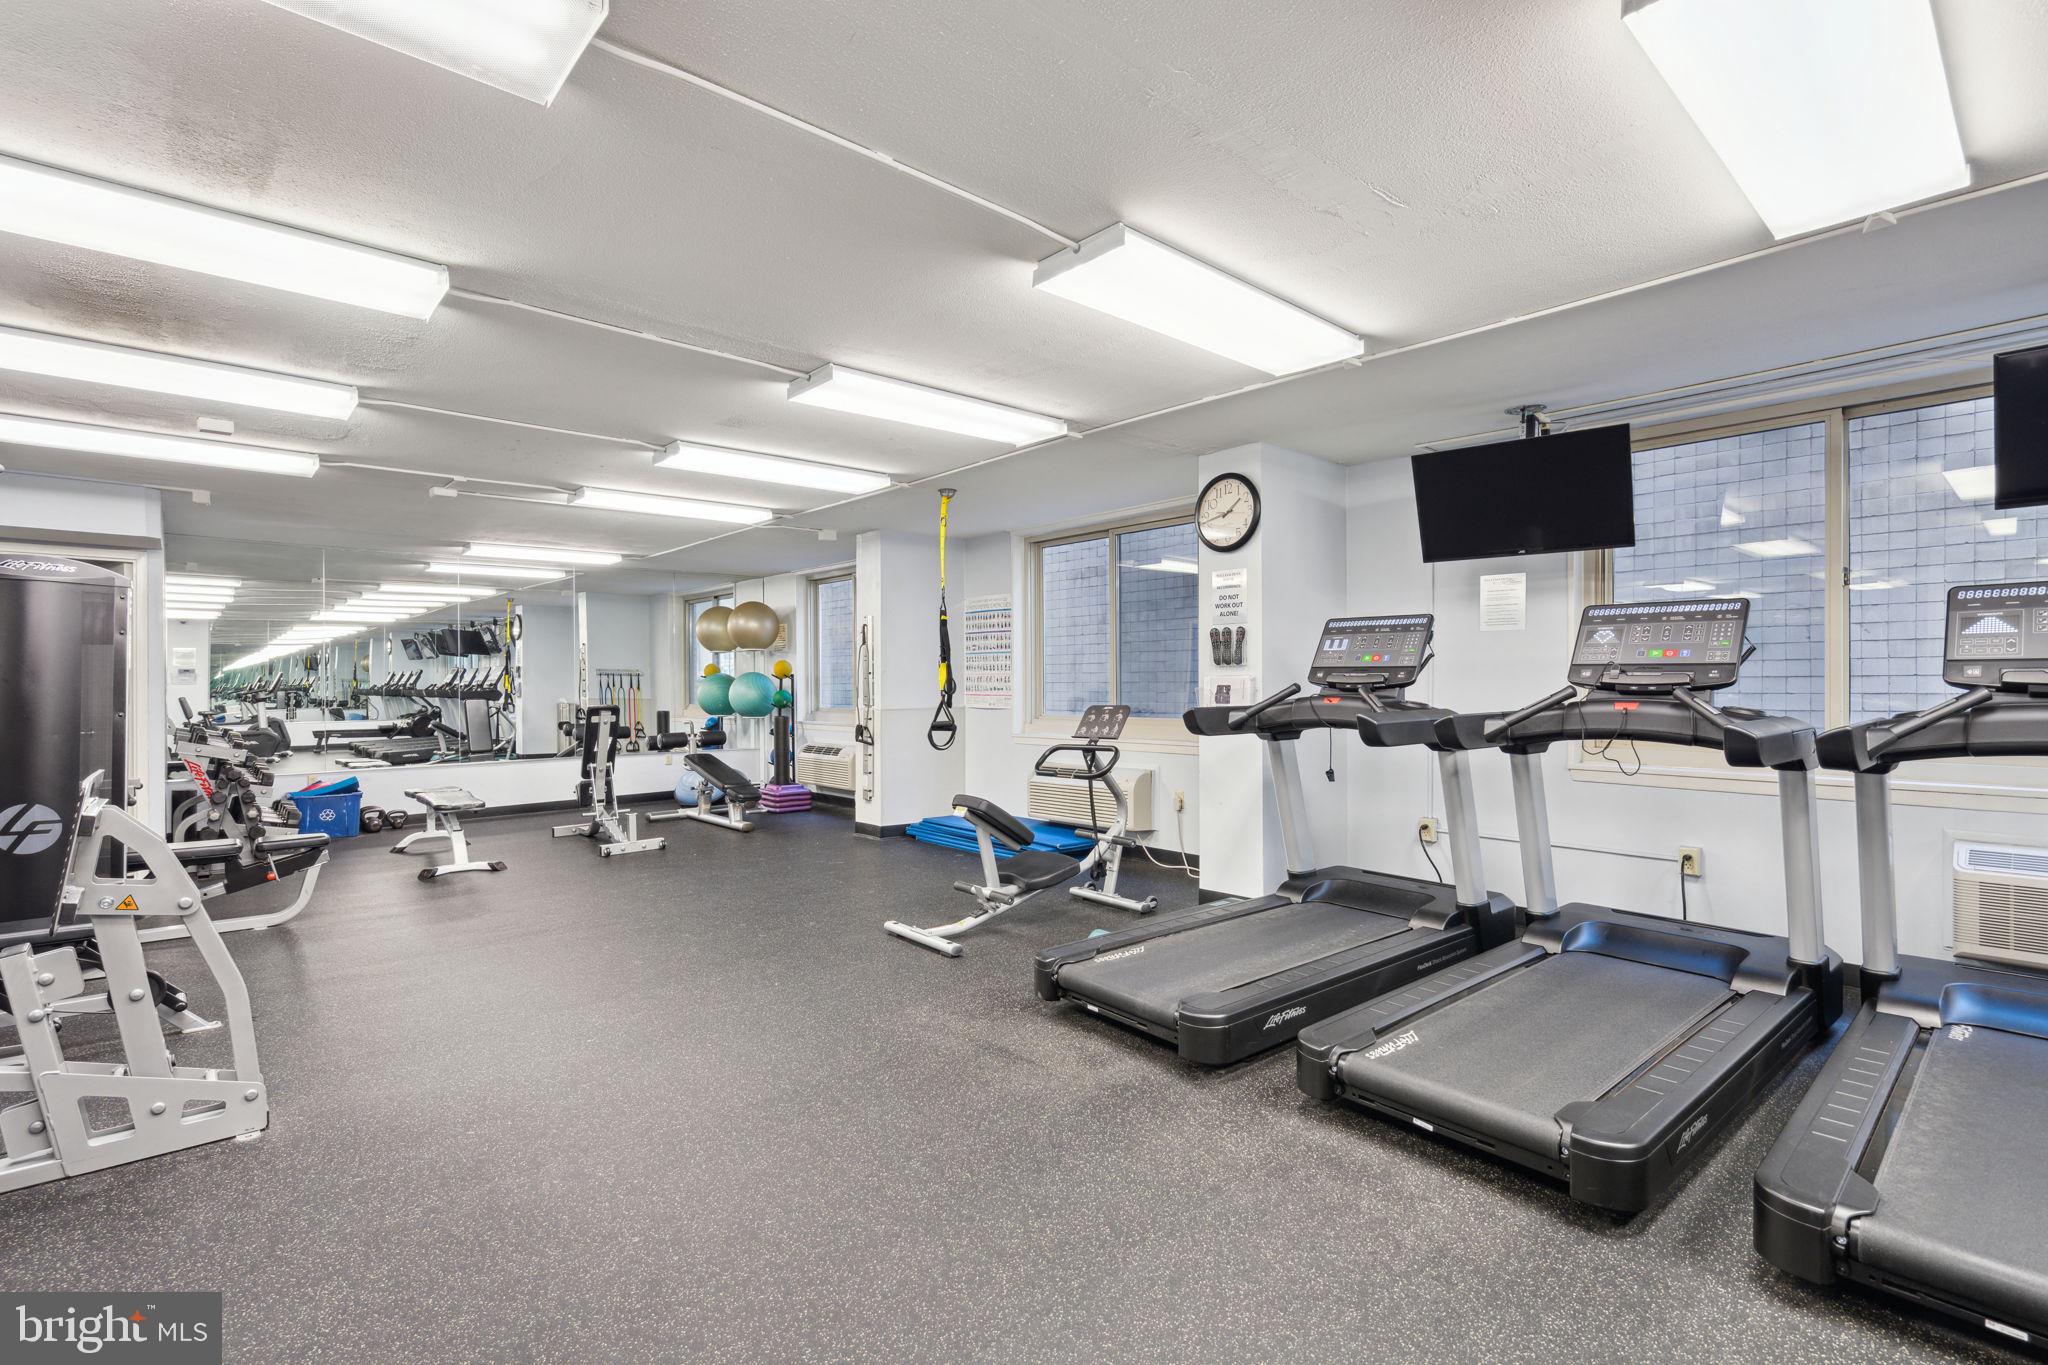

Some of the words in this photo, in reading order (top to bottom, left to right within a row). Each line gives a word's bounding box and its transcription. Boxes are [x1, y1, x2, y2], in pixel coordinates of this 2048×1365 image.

[1216, 488, 1222, 498] 11
[1225, 483, 1232, 494] 12
[1207, 499, 1218, 509] 10
